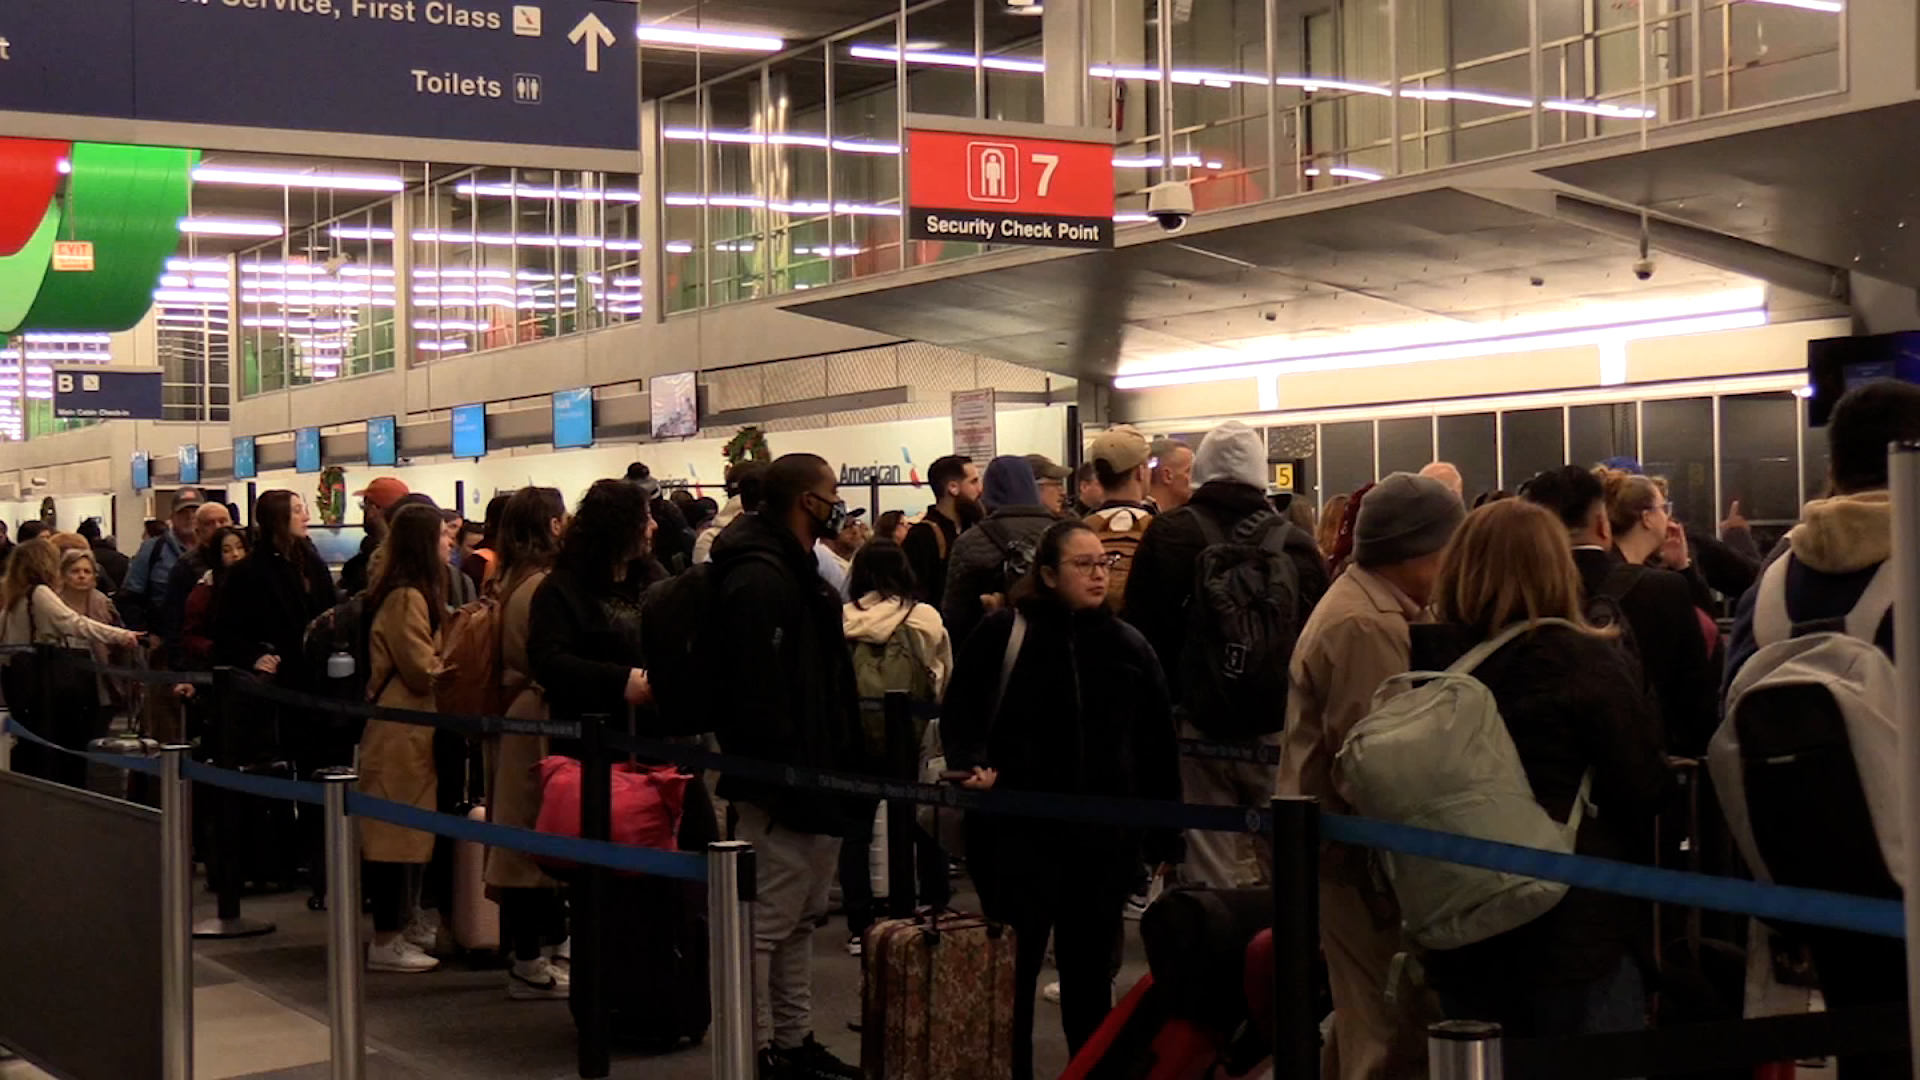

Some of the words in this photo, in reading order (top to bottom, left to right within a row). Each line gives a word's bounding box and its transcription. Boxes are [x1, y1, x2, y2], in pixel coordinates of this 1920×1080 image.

[352, 0, 416, 22] First
[425, 1, 501, 30] Class
[411, 69, 502, 98] Toilets
[1031, 153, 1059, 197] 7
[926, 215, 996, 240] Security
[1000, 219, 1053, 239] Check
[1058, 222, 1099, 241] Point
[58, 374, 74, 393] B
[840, 460, 900, 484] American
[1279, 467, 1289, 486] 5
